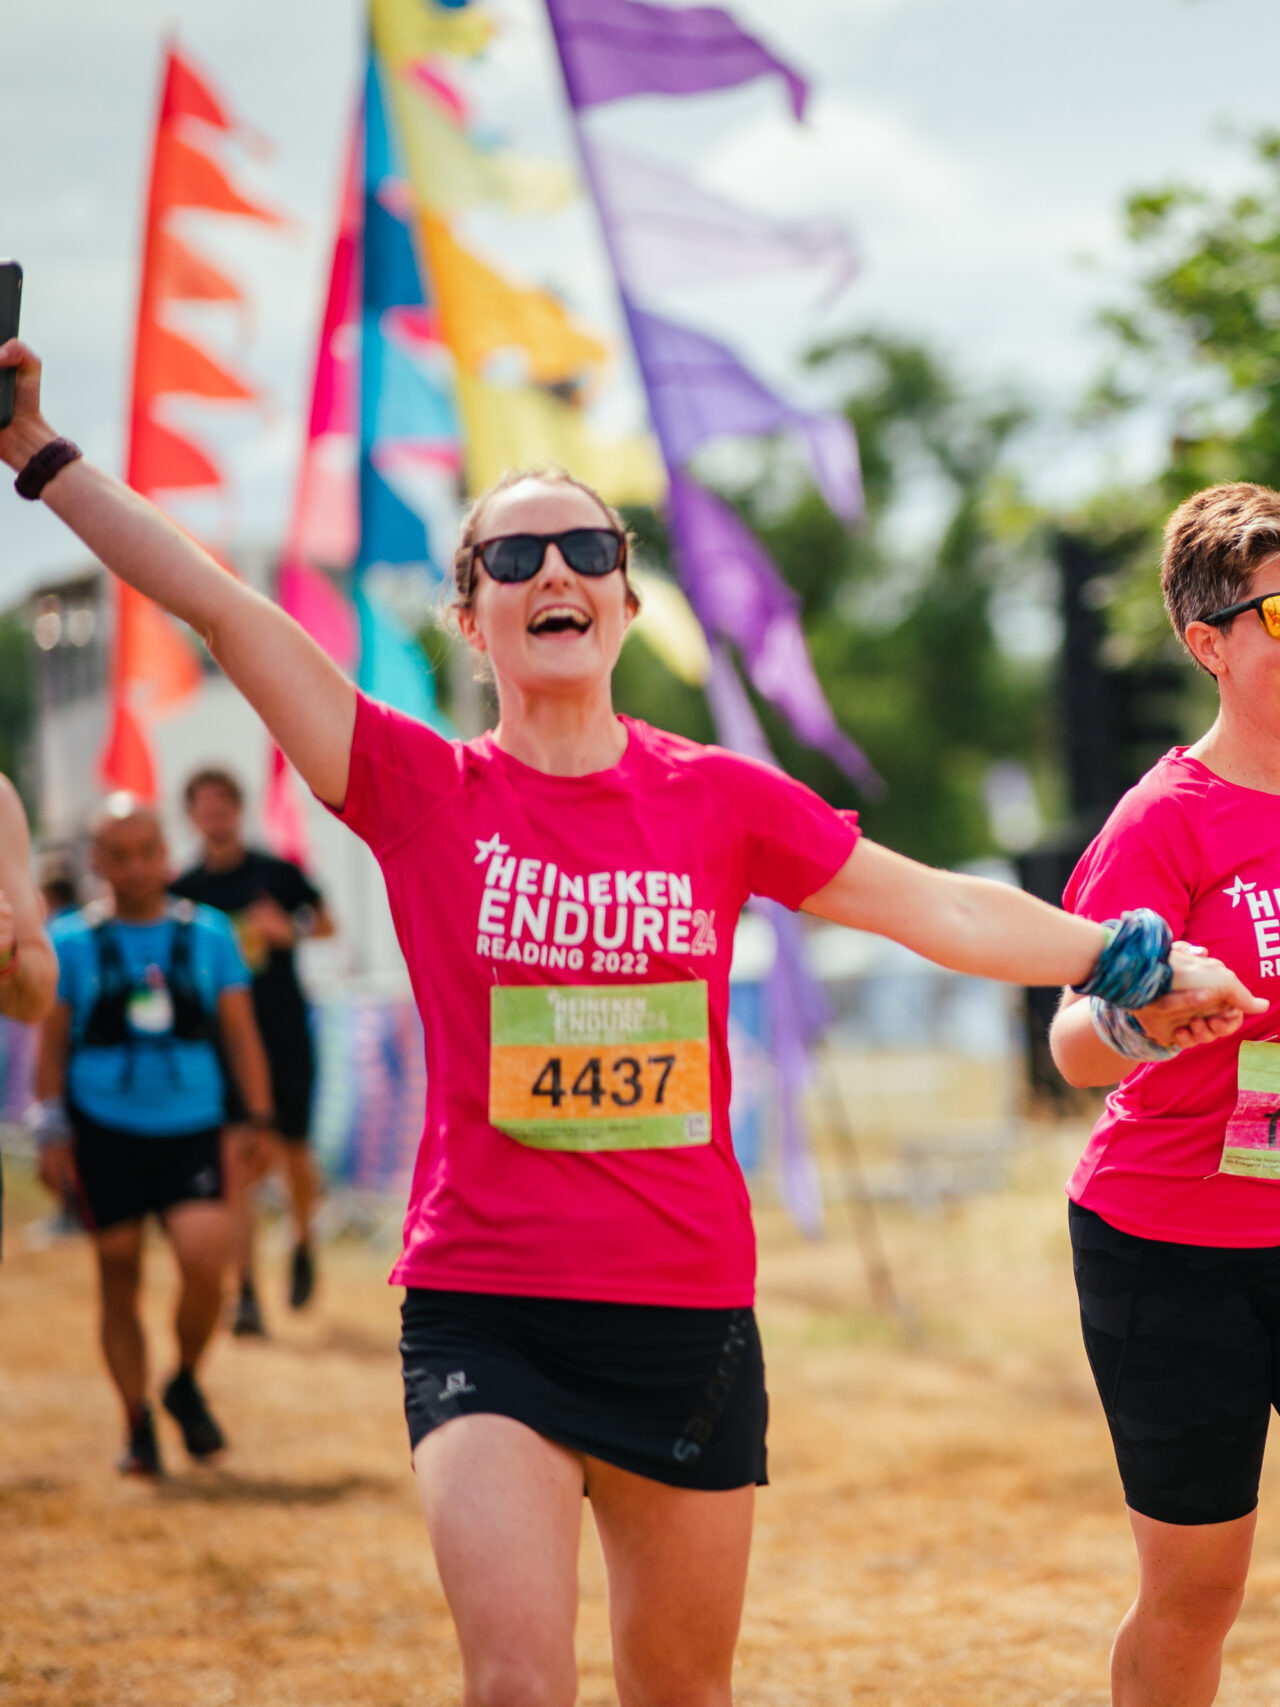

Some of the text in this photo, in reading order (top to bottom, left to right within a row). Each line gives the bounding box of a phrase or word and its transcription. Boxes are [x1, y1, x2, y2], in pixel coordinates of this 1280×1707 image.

[485, 855, 693, 906] HEINEKEN
[477, 888, 716, 956] ENDURE24
[476, 933, 648, 974] READING 2022
[554, 996, 647, 1013] HEINEKEN
[531, 1055, 676, 1107] 4437
